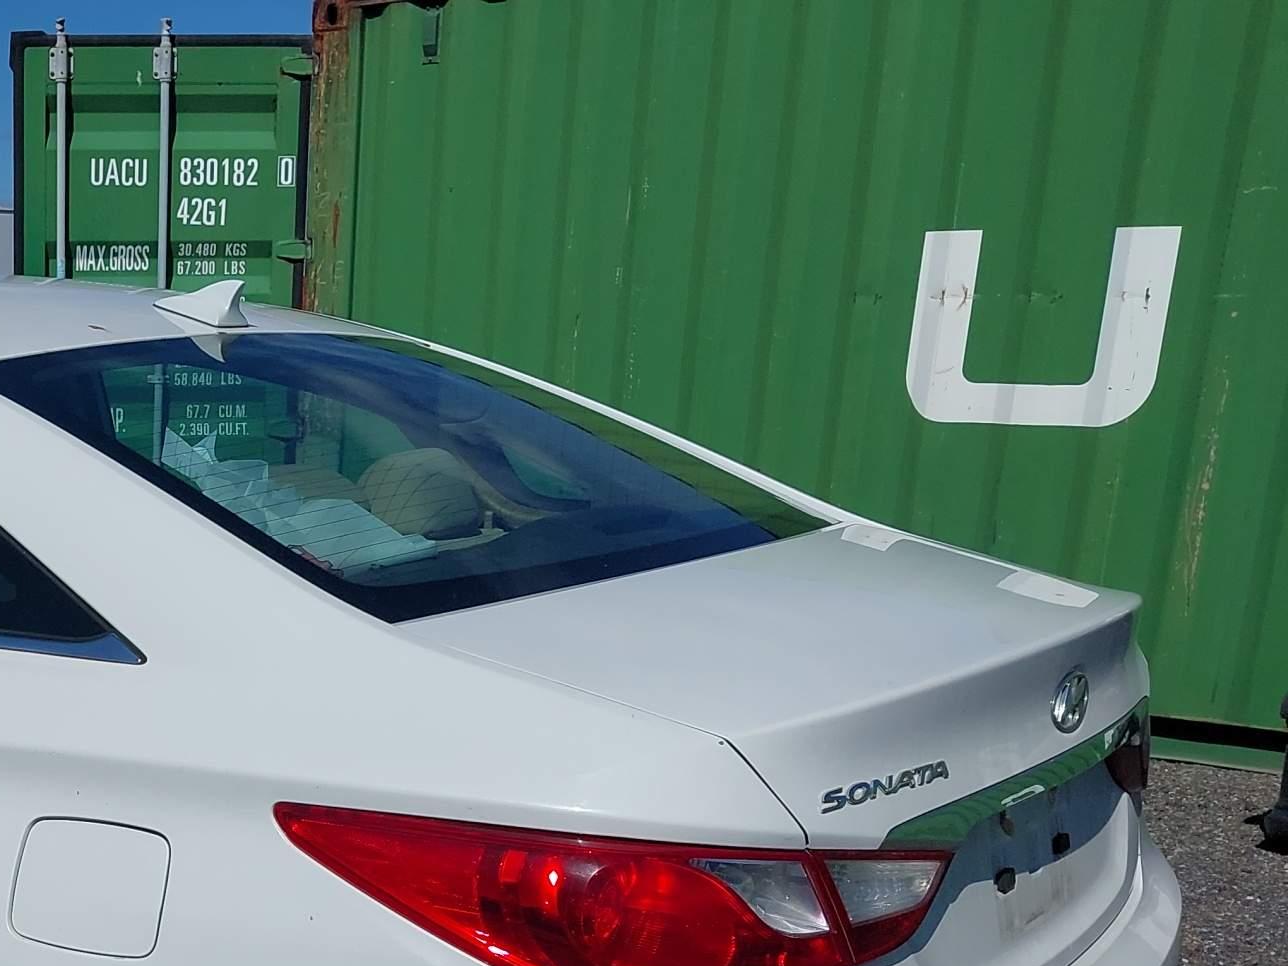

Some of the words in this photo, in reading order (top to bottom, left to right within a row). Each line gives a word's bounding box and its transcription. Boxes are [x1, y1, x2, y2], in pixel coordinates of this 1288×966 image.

[90, 158, 148, 187] UACU
[179, 157, 259, 187] 830182
[280, 157, 293, 185] 0
[176, 197, 228, 226] 42G1
[75, 244, 150, 272] MAX.GROSS
[178, 243, 217, 257] 30.480
[225, 243, 247, 257] KGS
[177, 260, 216, 275] 67.200
[223, 260, 246, 275] LBS
[905, 225, 1183, 429] U
[173, 371, 213, 387] 58.840
[220, 370, 243, 386] LBS
[185, 403, 211, 420] 67.7
[179, 422, 210, 438] 2.390
[820, 758, 951, 815] SONATA
